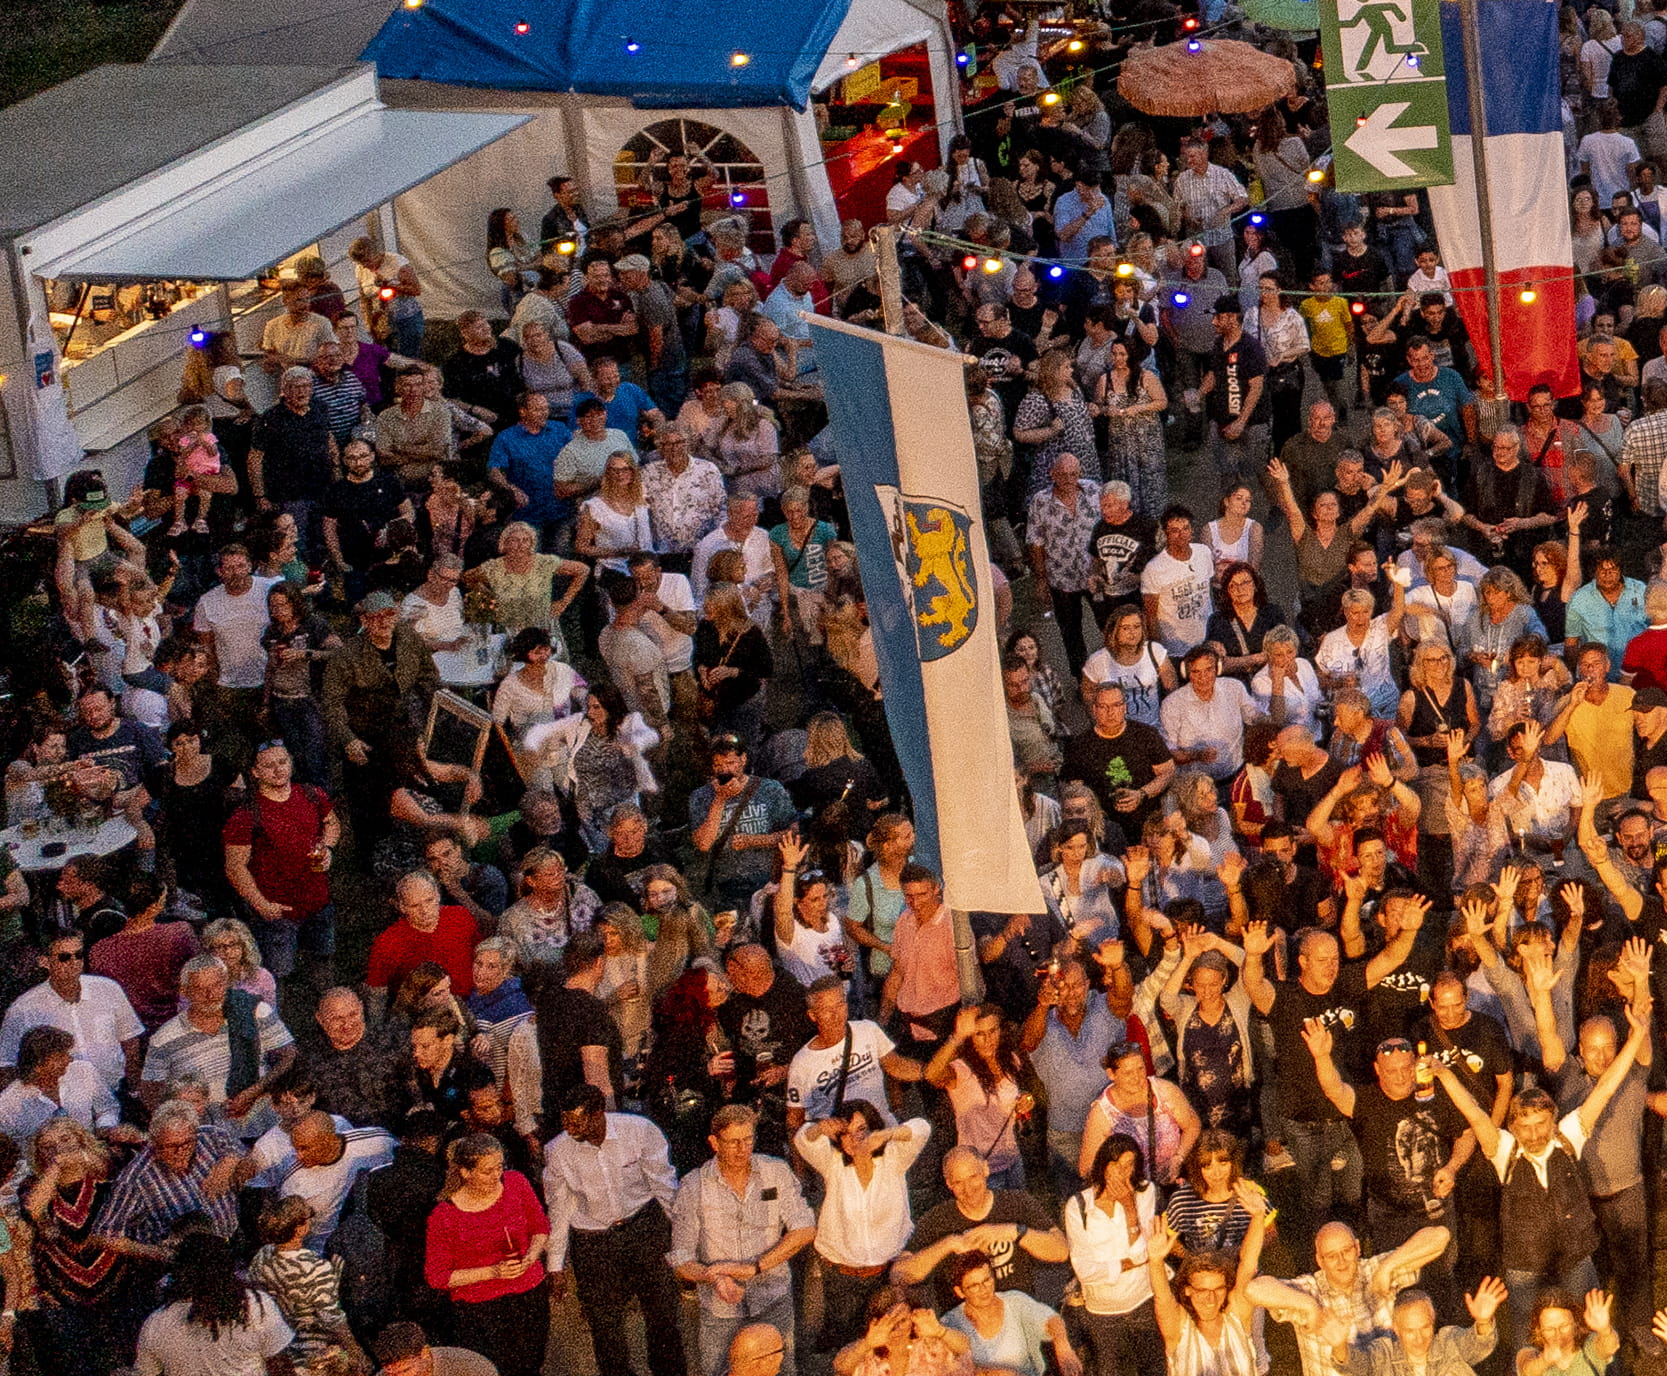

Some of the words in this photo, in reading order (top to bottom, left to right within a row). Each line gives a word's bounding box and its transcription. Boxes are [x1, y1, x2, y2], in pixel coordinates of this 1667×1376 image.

[1228, 376, 1239, 392] DO
[1228, 392, 1241, 415] JUST
[1097, 533, 1140, 552] OFFICIAL
